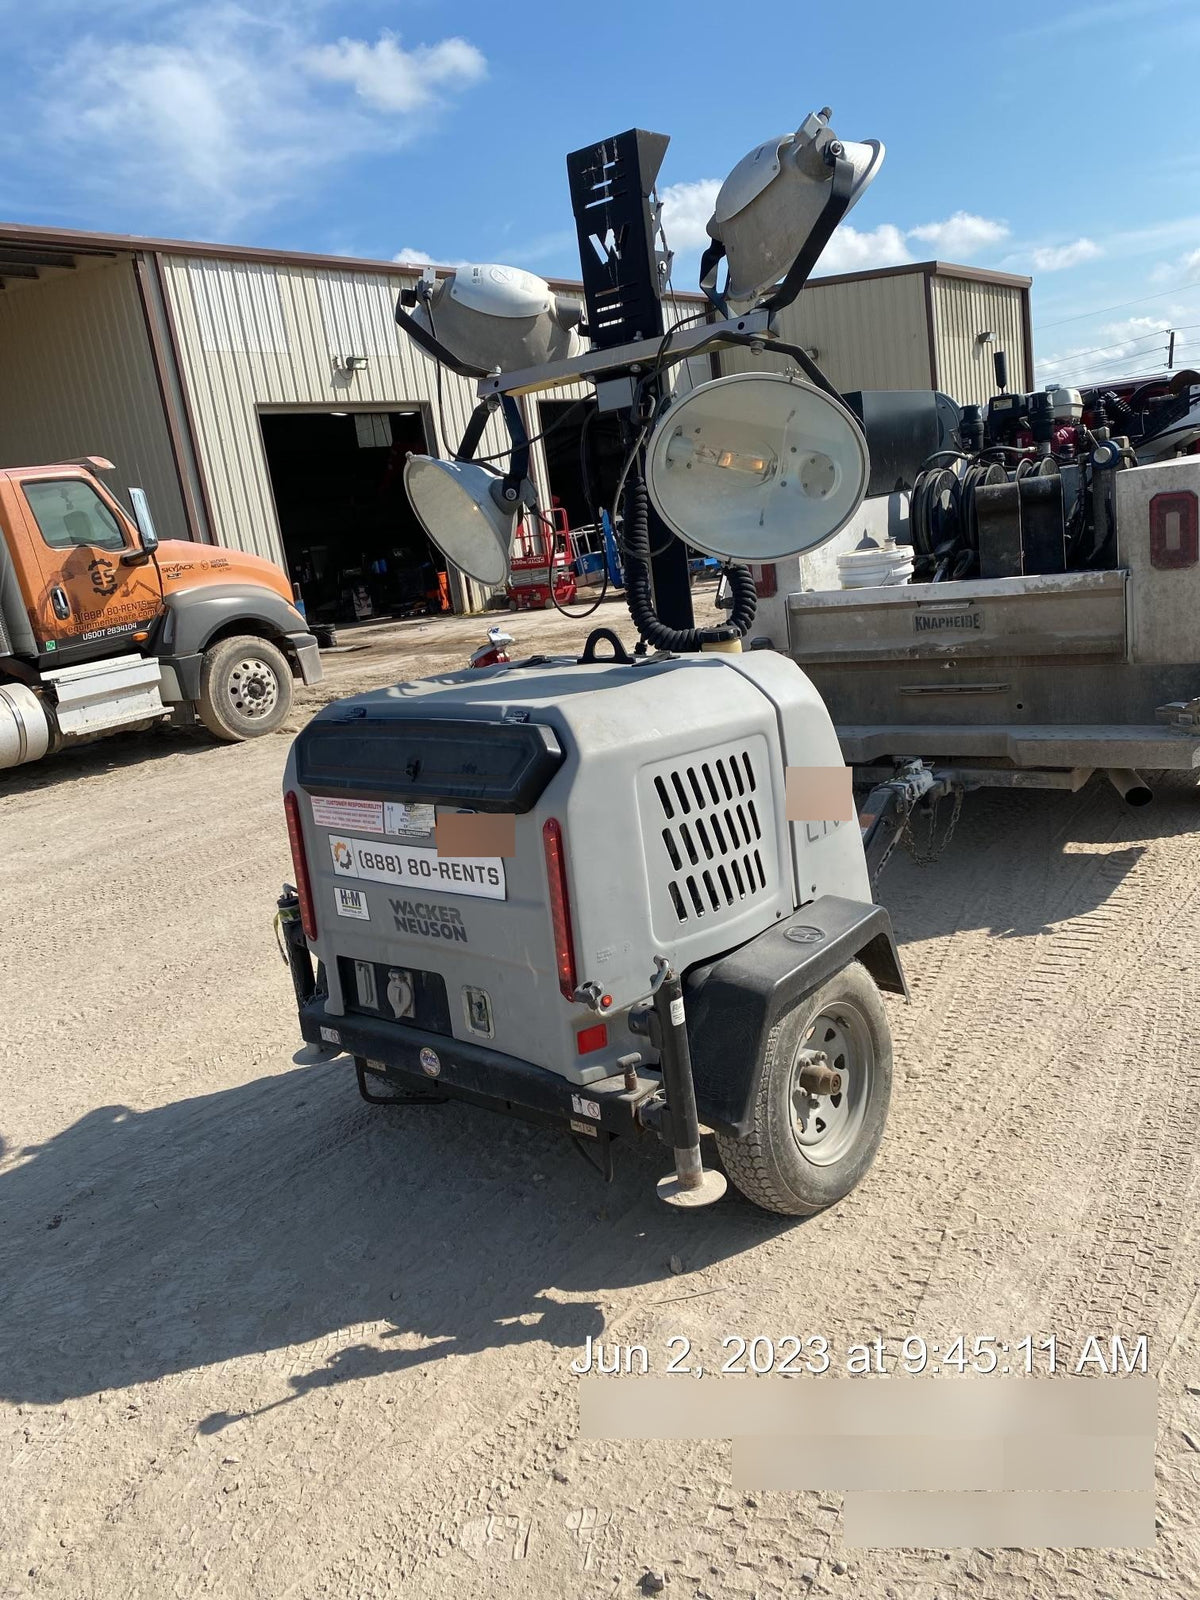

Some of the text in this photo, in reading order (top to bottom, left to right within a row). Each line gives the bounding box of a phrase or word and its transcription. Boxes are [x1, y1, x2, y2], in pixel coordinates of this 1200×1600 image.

[161, 563, 195, 573] SKYJACK
[106, 600, 148, 616] 80-RENTS
[66, 608, 156, 634] equipmentshare.com
[82, 622, 137, 641] USDOT 2834104
[915, 613, 980, 631] KNAPHEIDE
[358, 850, 500, 886] (888) 80-RENTS
[388, 898, 464, 925] WACKER
[393, 915, 468, 942] NEUSON
